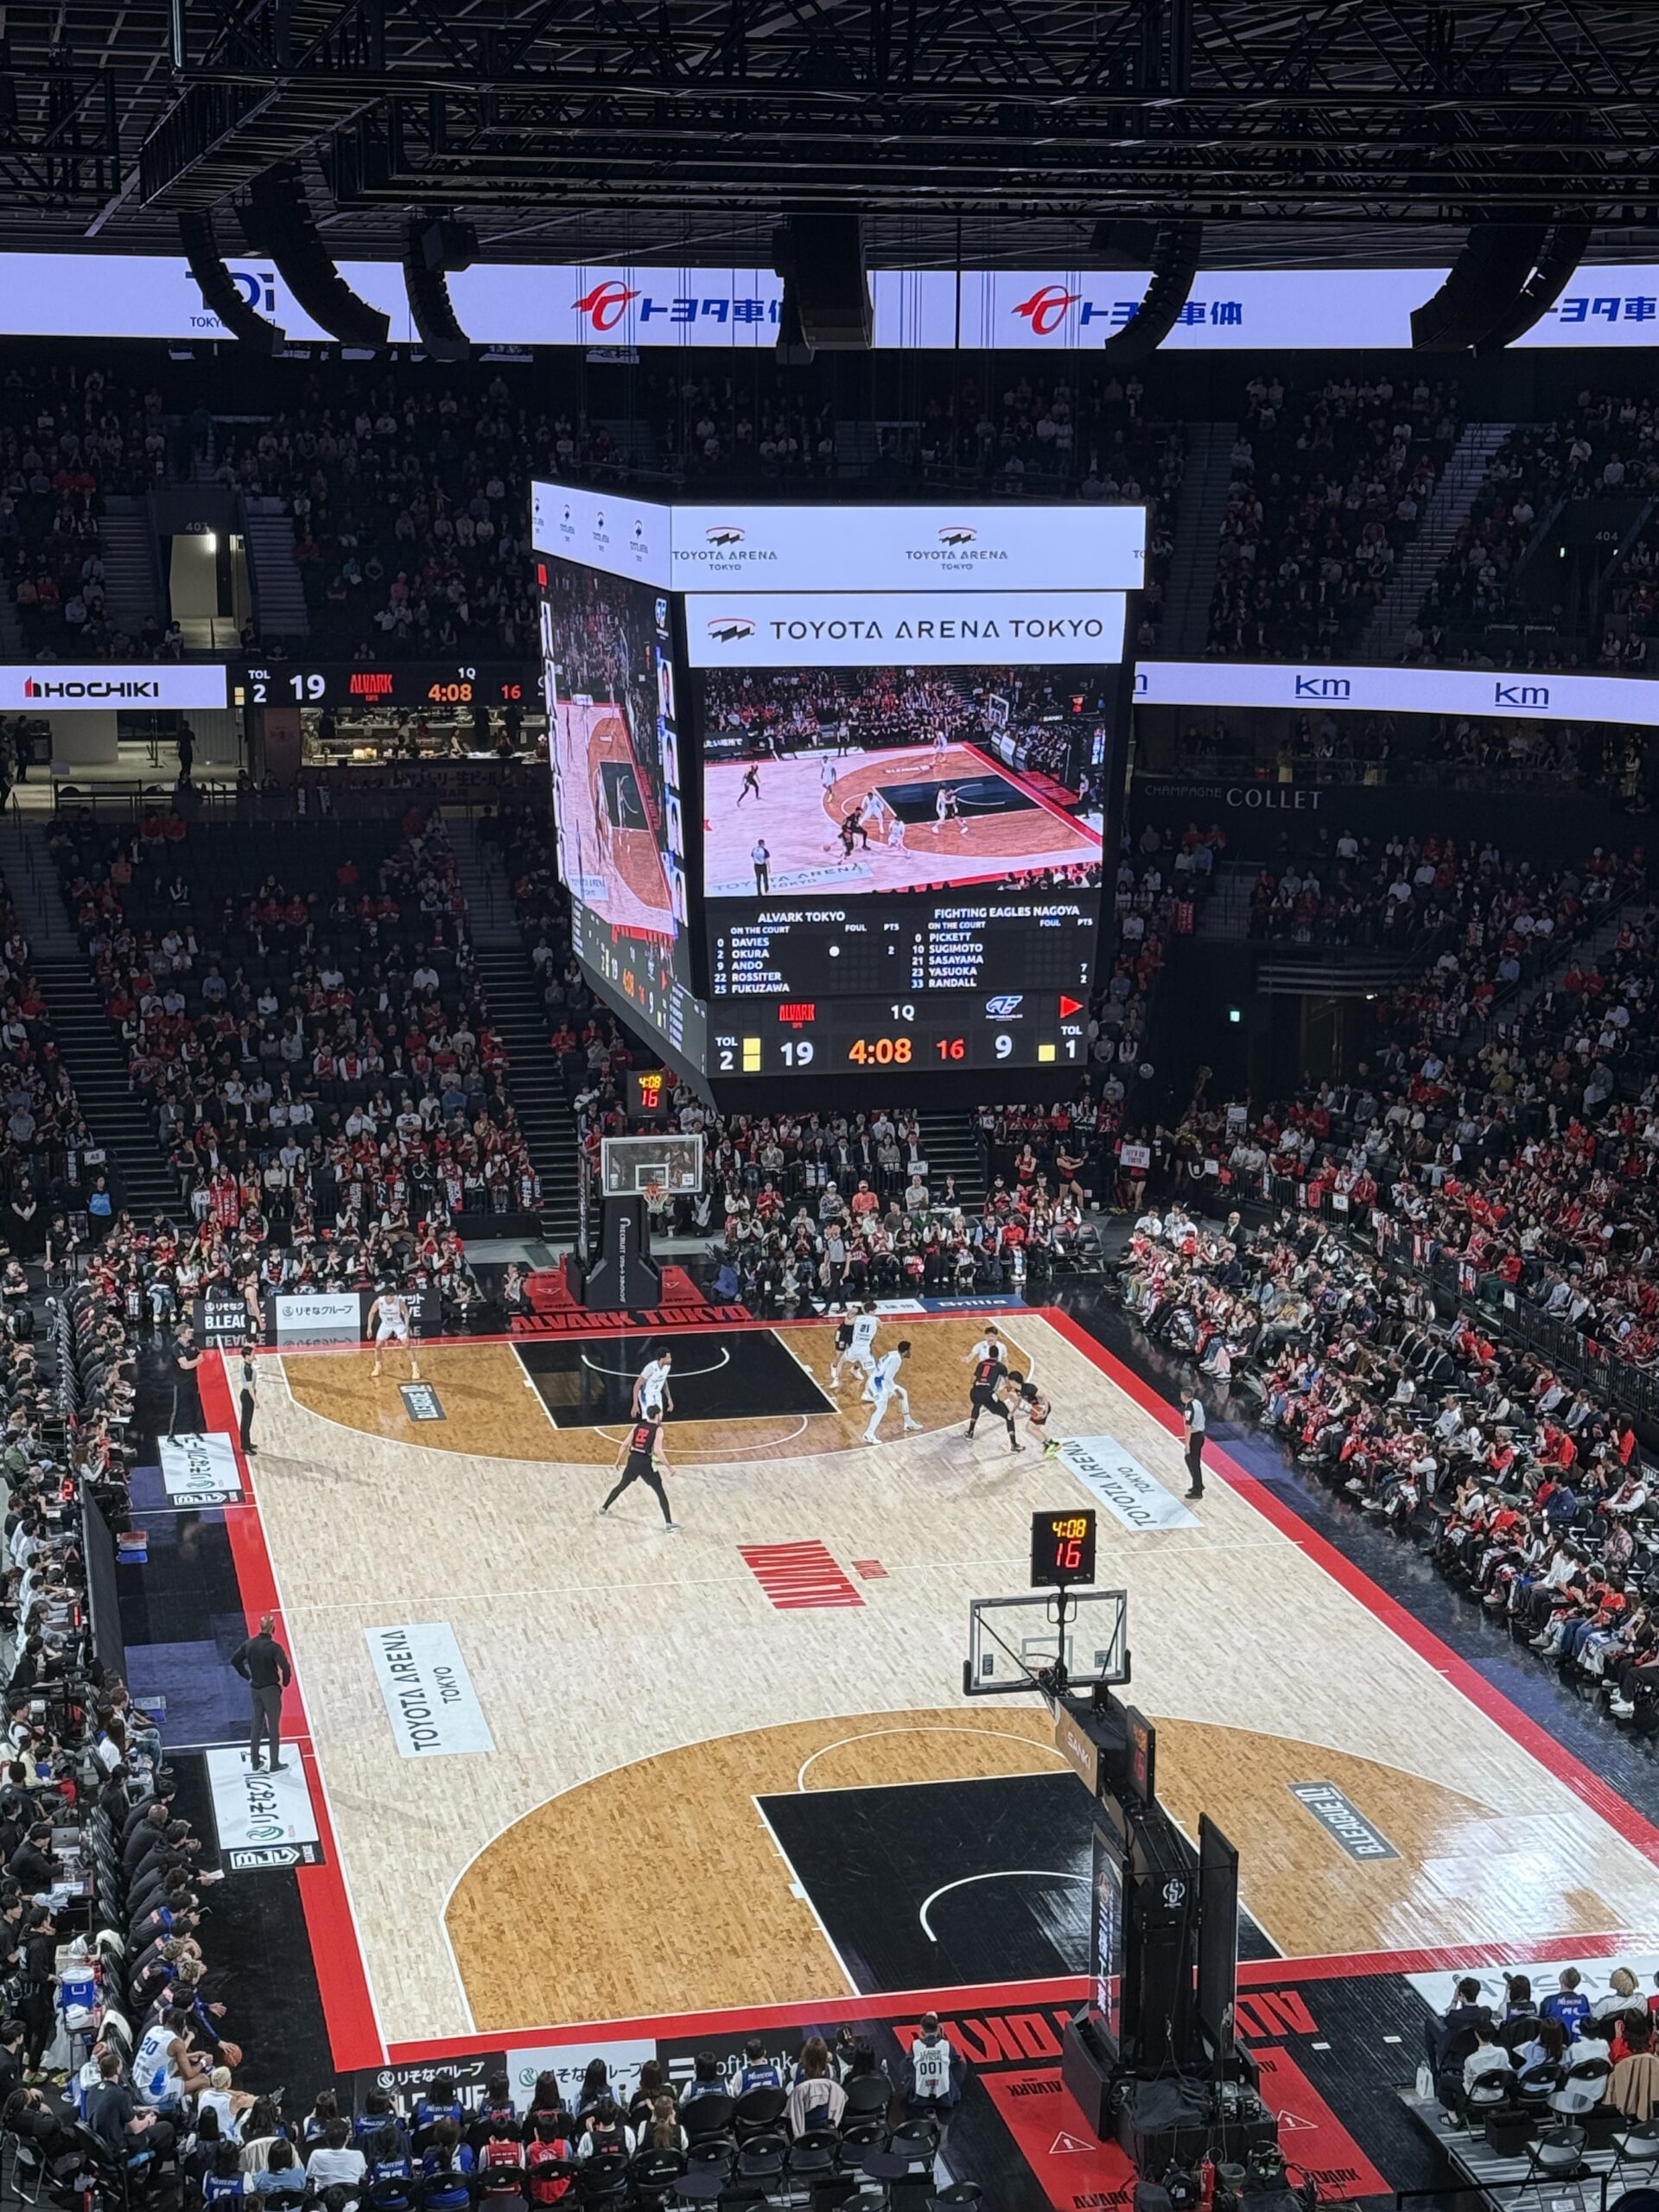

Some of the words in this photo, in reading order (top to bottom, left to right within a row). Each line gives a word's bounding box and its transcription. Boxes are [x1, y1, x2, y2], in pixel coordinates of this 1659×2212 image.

[1081, 302, 1243, 326] トヨ車体
[1547, 296, 1657, 322] ヨタ車
[1595, 531, 1618, 541] 404
[671, 551, 724, 561] TOYOTA
[728, 551, 778, 560] ARENA
[906, 550, 956, 560] TOYOTA
[960, 550, 1007, 559] ARENA
[770, 621, 883, 639] TOYOTA
[895, 620, 1000, 639] ARENA
[1009, 620, 1103, 638] TOKYO
[248, 670, 271, 680] TOL
[458, 668, 476, 681] 1Q
[45, 683, 158, 697] HOCHIKI
[252, 683, 267, 702] 2
[289, 674, 326, 700] 19
[428, 683, 472, 702] 4:08
[501, 684, 521, 700] 16
[1295, 676, 1350, 696] km
[1495, 683, 1549, 705] km
[1145, 785, 1222, 798] CHAMPAGNE
[1226, 788, 1323, 809] COLLET
[714, 874, 790, 891] TOYTA
[758, 912, 803, 923] ALVARK
[805, 911, 846, 922] TOKYO
[934, 908, 987, 918] FIGHTING
[989, 907, 1031, 917] EAGLES
[1033, 906, 1080, 916] NAGOYA
[762, 925, 791, 934] COURT
[959, 920, 986, 929] COURT
[1077, 918, 1093, 926] PTS
[716, 938, 724, 947] 0
[732, 937, 769, 946] DAVIES
[914, 933, 922, 943] 0
[930, 932, 971, 942] PICKETT
[716, 950, 724, 959] 2
[732, 949, 770, 958] OKURA
[887, 946, 895, 955] 2
[912, 945, 925, 954] 10
[929, 944, 983, 953] SUGIMOTO
[716, 962, 724, 970] 9
[732, 960, 763, 970] ANDO
[912, 957, 923, 965] 21
[928, 955, 984, 965] SASAYAMA
[714, 973, 727, 982] 22
[732, 972, 782, 982] ROSSITER
[912, 968, 924, 977] 23
[928, 967, 977, 976] YASUOKA
[1080, 963, 1088, 972] 7
[714, 984, 727, 994] 25
[732, 982, 790, 993] FUKUZAWA
[911, 979, 924, 988] 33
[928, 977, 977, 988] RANDALL
[1080, 975, 1088, 983] 2
[891, 1005, 915, 1021] 1Q
[1061, 1026, 1083, 1035] TOL
[715, 1037, 738, 1047] TOL
[936, 1038, 965, 1060] 16
[995, 1034, 1013, 1059] 9
[1065, 1039, 1076, 1058] 1
[780, 1041, 814, 1066] 19
[849, 1038, 912, 1065] 4:08
[720, 1051, 734, 1071] 2
[639, 1075, 662, 1090] 4:08
[642, 1089, 658, 1108] 16
[296, 1305, 353, 1317] りそなグループ
[511, 1311, 611, 1332] ALVARK
[637, 1306, 753, 1326] TOKYO
[1063, 1440, 1111, 1479] ARENA
[1117, 1466, 1155, 1494] TOKYO
[1100, 1482, 1157, 1526] TOYOTA
[1052, 1519, 1086, 1538] 4:08
[1056, 1540, 1081, 1567] 16
[380, 1630, 421, 1683] ARENA
[432, 1666, 462, 1704] TOKYO
[398, 1688, 442, 1751] TOYOTA
[1068, 1731, 1090, 1770] SANKI
[1313, 1801, 1387, 1854] B.LEAGUE
[141, 2036, 160, 2056] 20
[919, 2062, 942, 2075] 001
